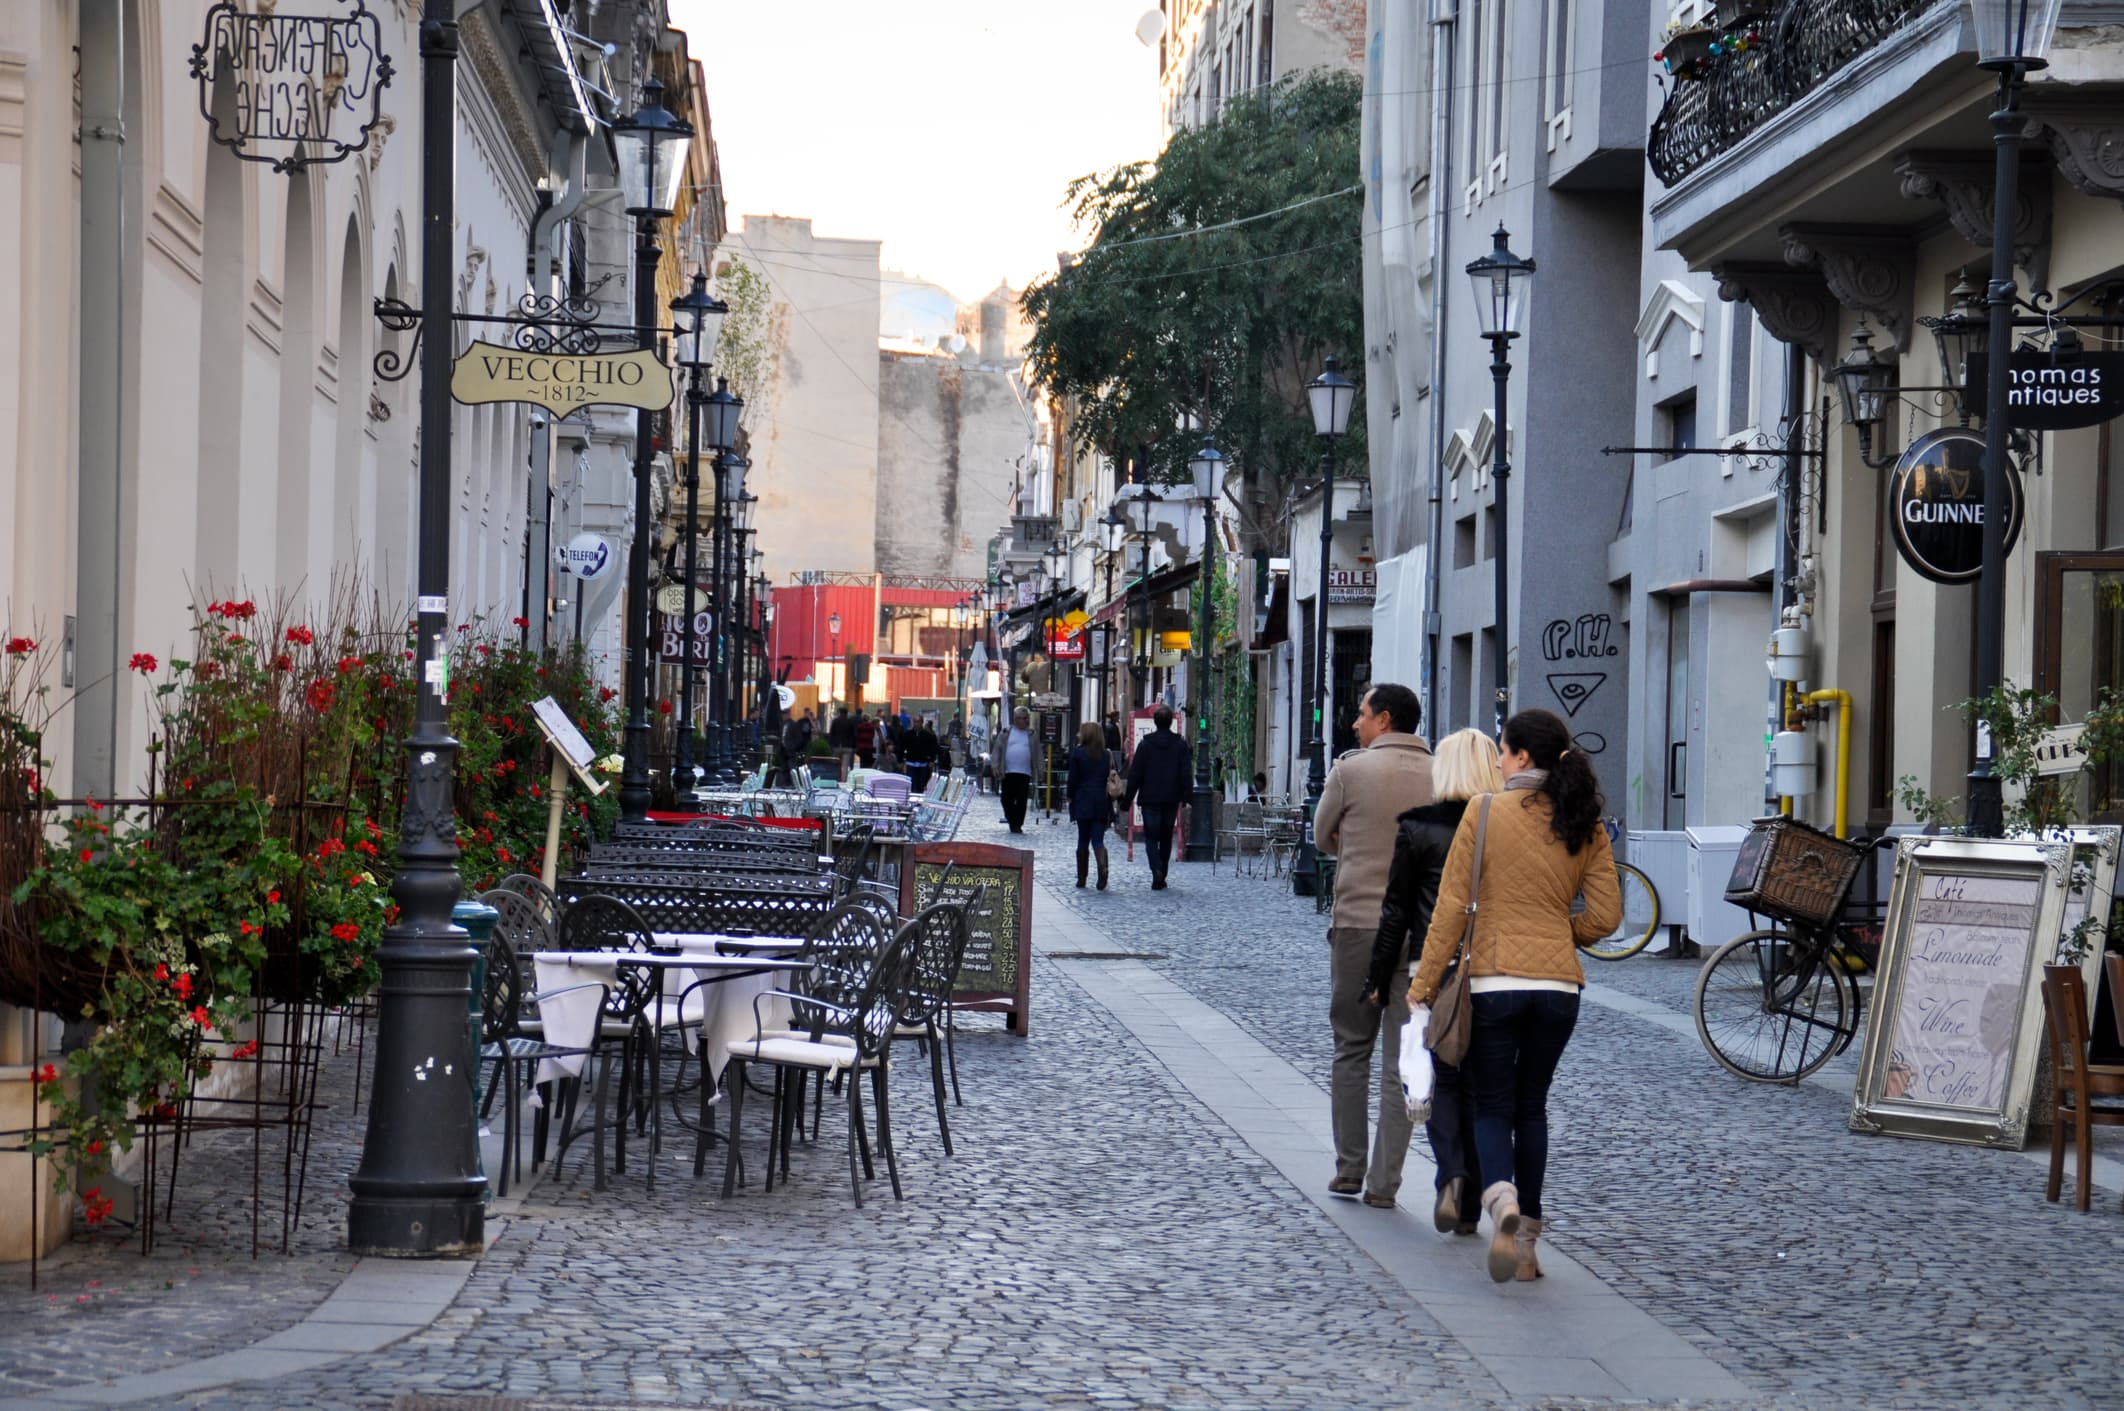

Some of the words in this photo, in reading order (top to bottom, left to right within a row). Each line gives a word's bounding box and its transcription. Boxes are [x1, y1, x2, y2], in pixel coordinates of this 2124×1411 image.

[480, 356, 644, 385] VECCHIO
[2008, 368, 2101, 384] omas
[2008, 387, 2101, 406] ntiques
[1905, 499, 2007, 524] GUINNE
[569, 550, 599, 561] TELEFON
[1935, 876, 1967, 913] Café
[1918, 997, 1969, 1035] Wine
[1923, 1061, 1979, 1104] Coffee
